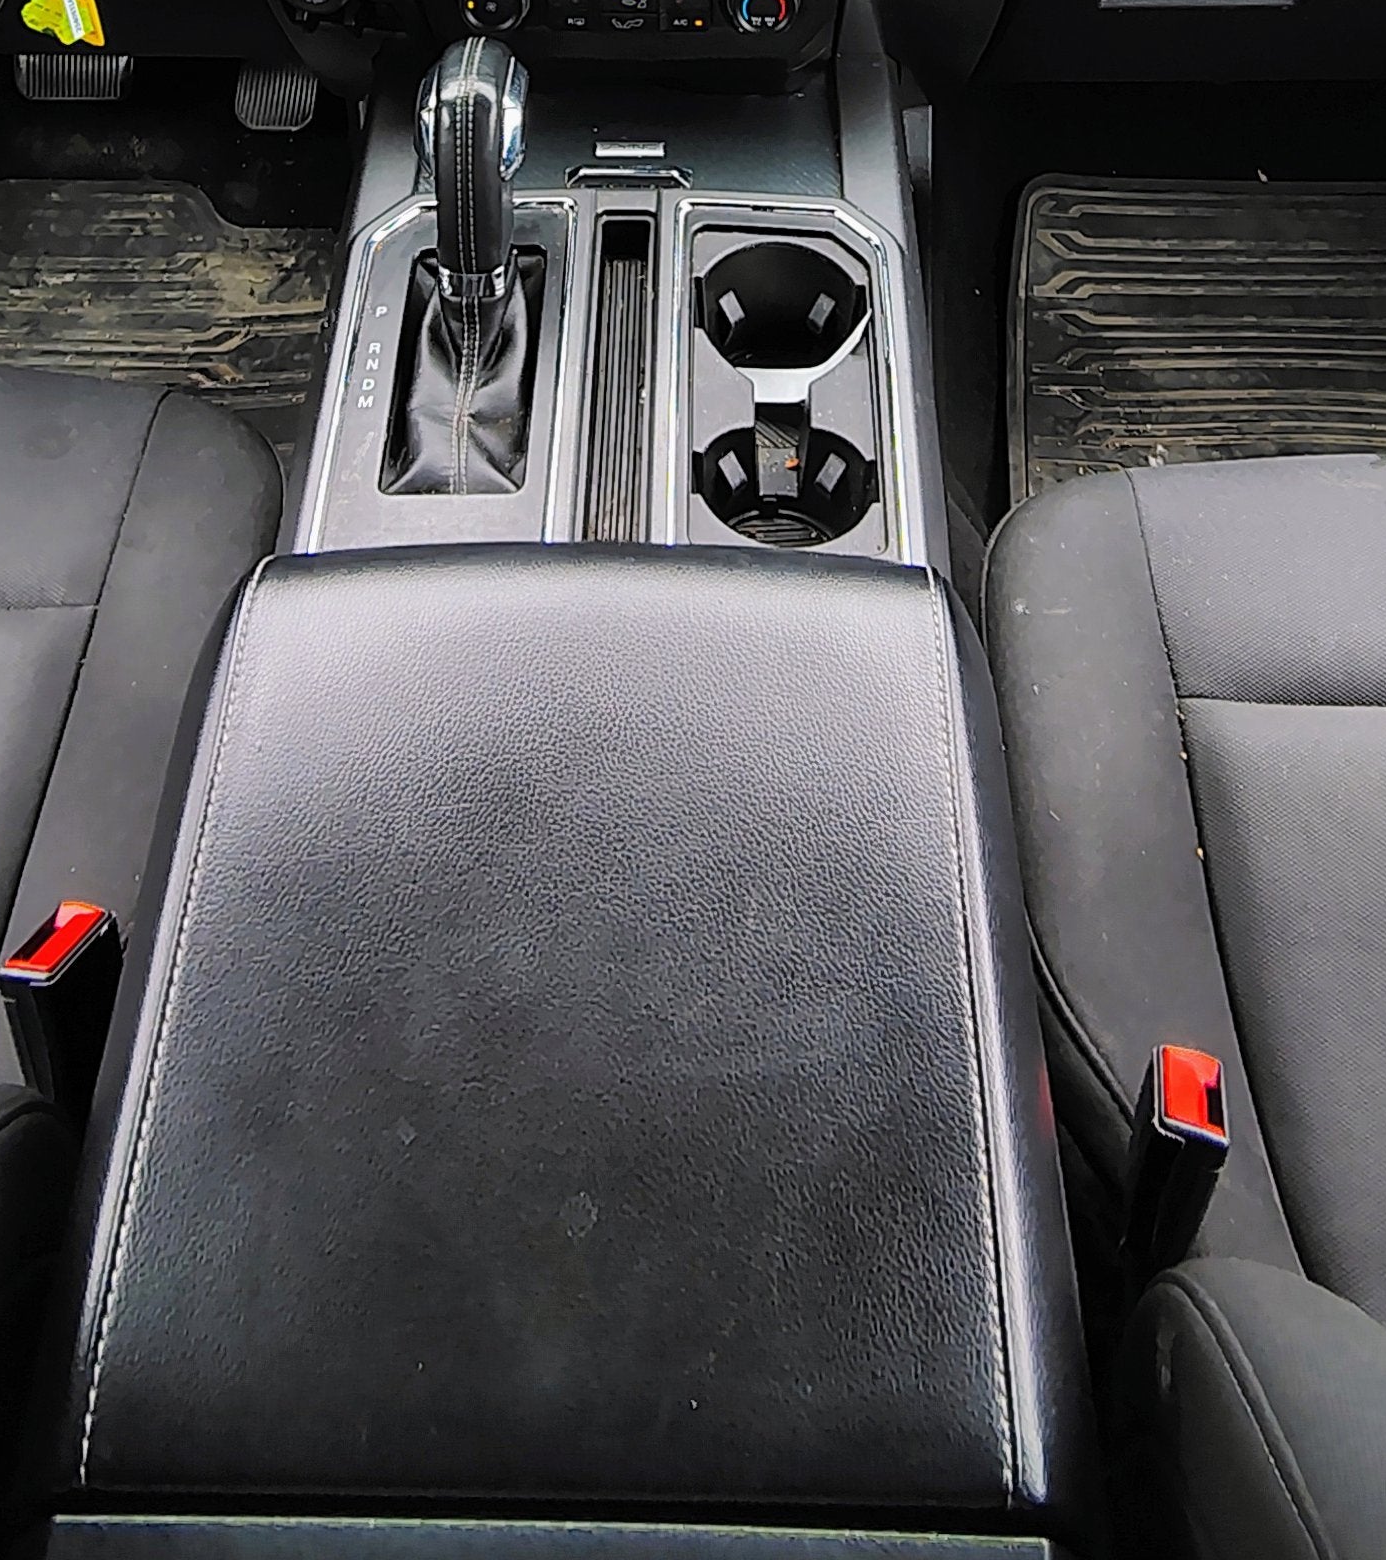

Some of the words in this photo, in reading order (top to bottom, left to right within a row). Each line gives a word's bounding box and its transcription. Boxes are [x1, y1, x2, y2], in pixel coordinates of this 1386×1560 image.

[673, 18, 688, 26] A/C
[375, 306, 388, 318] P
[368, 342, 381, 354] R
[366, 358, 379, 371] N
[362, 378, 375, 391] D
[357, 395, 374, 408] M
